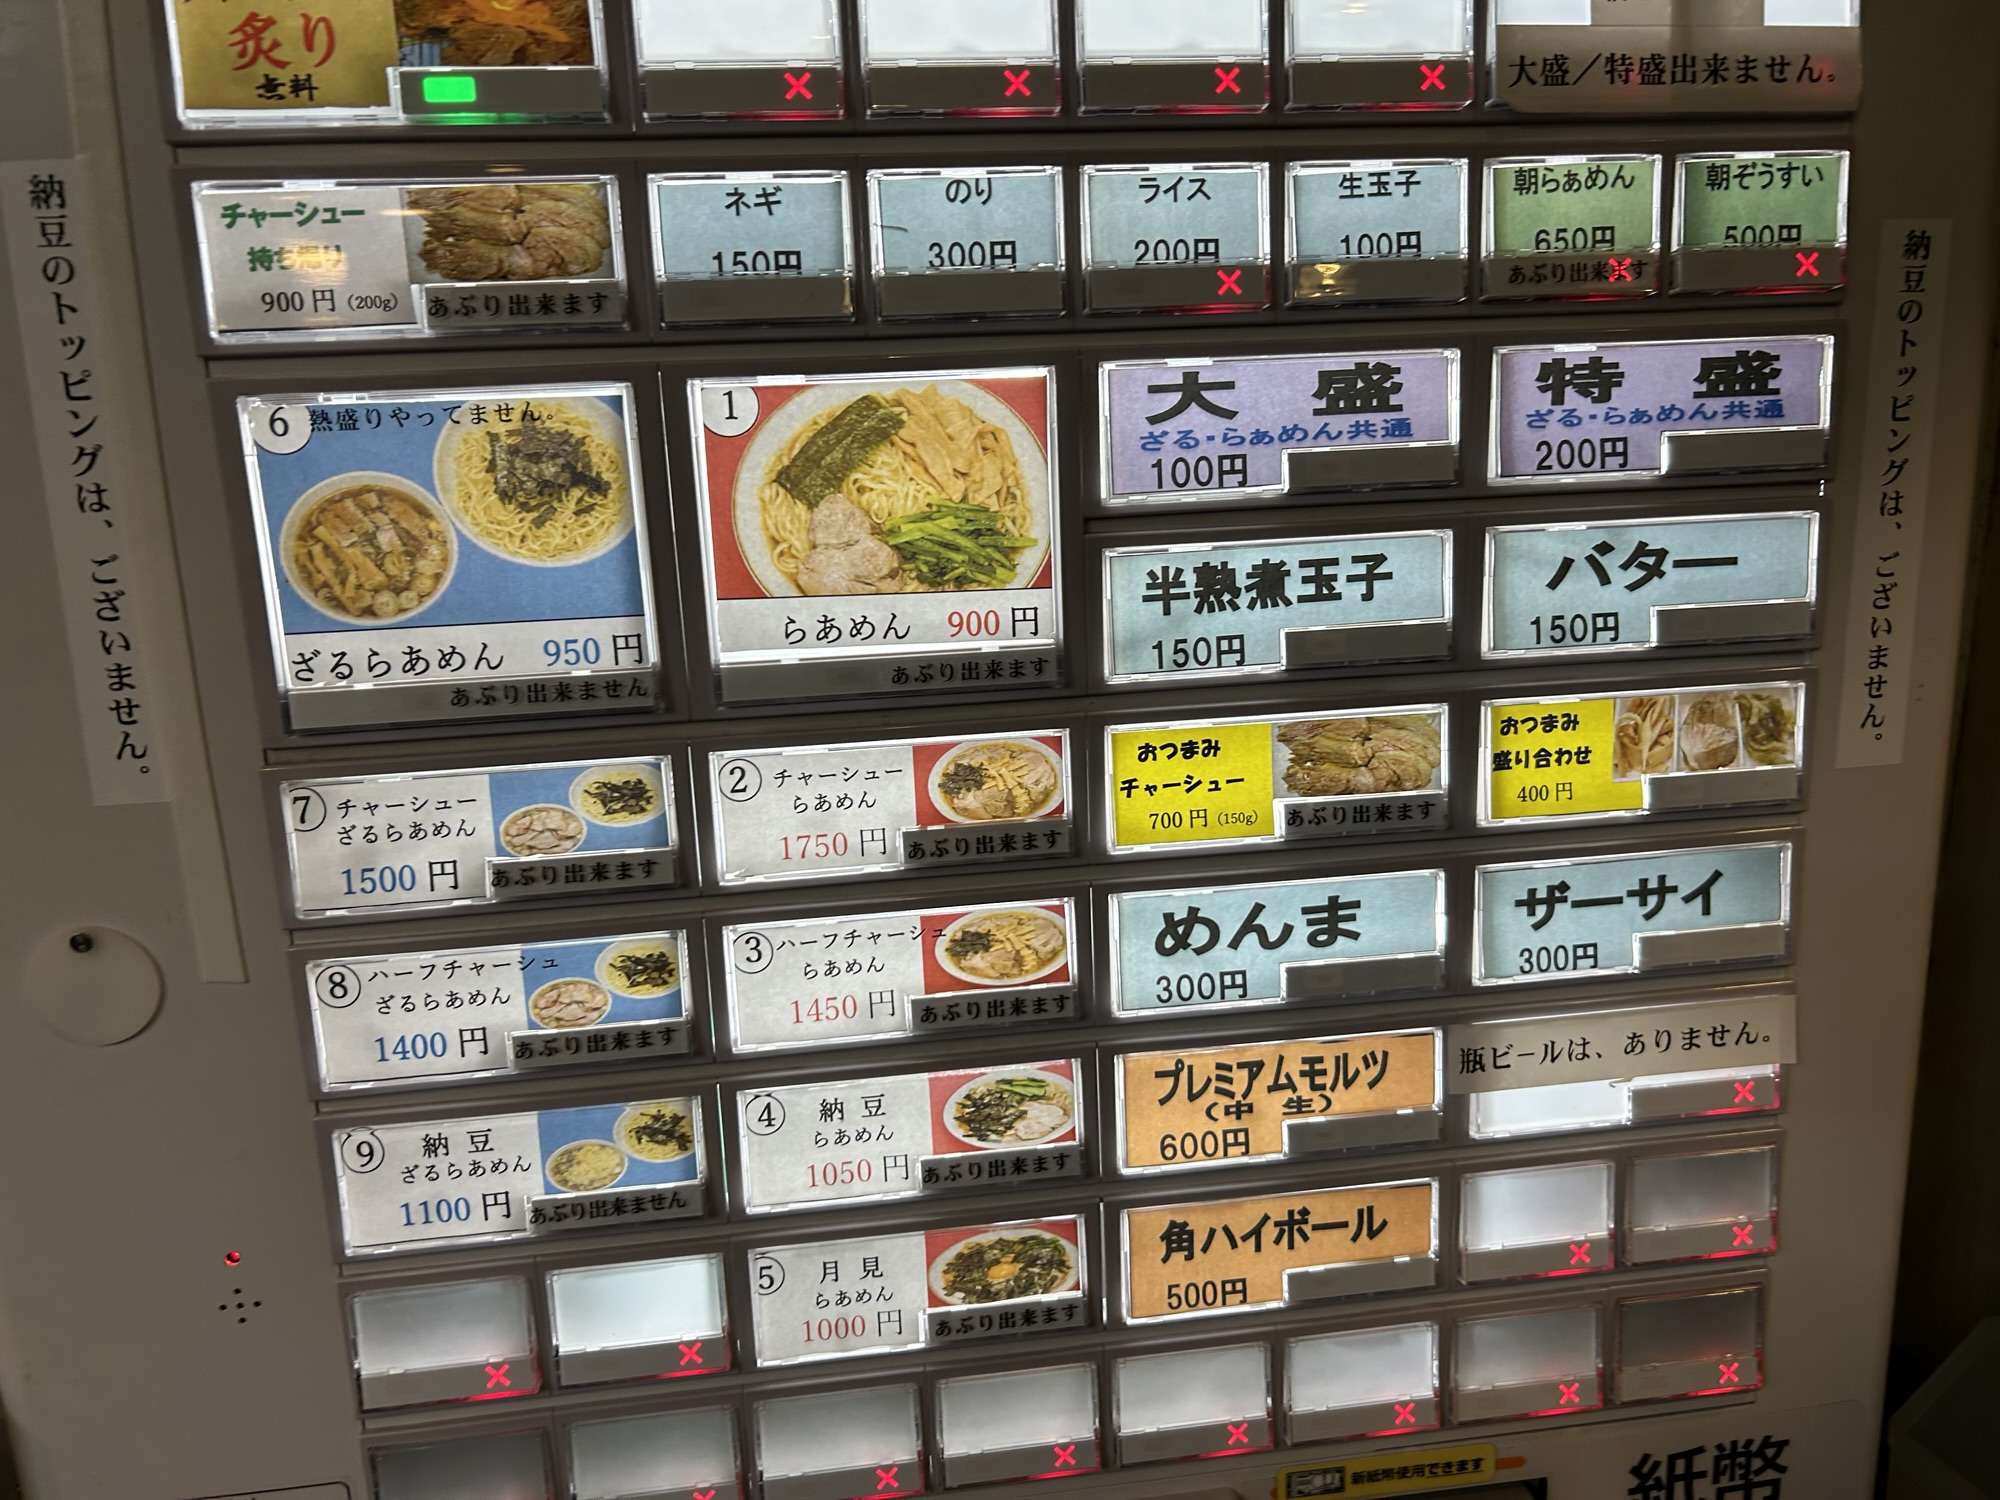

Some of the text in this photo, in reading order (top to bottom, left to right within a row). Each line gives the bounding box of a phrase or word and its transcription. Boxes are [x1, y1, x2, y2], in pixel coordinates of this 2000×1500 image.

[227, 11, 336, 71] 炙り
[1507, 52, 1836, 88] 大盛／特盛出来ません。
[254, 73, 319, 102] 無料
[945, 177, 993, 205] のり
[1138, 175, 1213, 203] ライス
[1338, 170, 1421, 199] 生玉子
[1705, 162, 1824, 191] 朝ぞうすい
[221, 201, 365, 229] チャーシュー
[724, 186, 783, 216] ネギ
[1340, 230, 1421, 259] 100円
[1535, 224, 1615, 253] 650円
[1724, 224, 1801, 248] 500円
[712, 250, 802, 276] 150円
[928, 240, 1017, 269] 300円
[1134, 237, 1221, 267] 200円
[1509, 259, 1648, 284] あぶり出来ます
[428, 292, 608, 318] あぶり出来ます
[310, 402, 557, 433] 熱盛りやってません。
[1535, 436, 1628, 471] 200円
[28, 173, 150, 774] 納豆のトッピングは、ございません。
[1151, 453, 1248, 490] 100円
[1545, 540, 1739, 593] バター
[1142, 553, 1393, 616] 半熟煮玉子
[785, 612, 910, 645] らあめん
[1530, 612, 1619, 645] 150円
[291, 642, 505, 682] ざるらあめん
[1151, 634, 1246, 670] 150円
[891, 658, 1050, 685] あぶり出来ます
[450, 678, 649, 707] あぶり出来ません
[1499, 712, 1580, 737] おつまみ
[1137, 738, 1221, 762] おつまみ
[1492, 745, 1593, 772] 盛り合わせ
[773, 766, 903, 788] チャーシュー
[1120, 774, 1245, 799] チャーシュー
[336, 795, 477, 819] チャーシュー
[793, 790, 877, 814] らあめん
[1287, 801, 1437, 828] あぶり出来ます
[336, 819, 476, 845] ざるらあめん
[780, 832, 848, 860] 1750
[908, 829, 1063, 860] あぶり出来ます
[341, 864, 416, 895] 1500
[490, 858, 659, 888] あぶり出来ます
[1514, 869, 1724, 932] ザーサイ
[1155, 895, 1362, 958] めんま
[804, 956, 885, 980] らあめん
[1519, 942, 1599, 974] 300円
[376, 986, 511, 1016] ざるらあめん
[1156, 970, 1248, 1004] 300円
[790, 994, 857, 1024] 1450
[920, 994, 1071, 1024] あぶり出来ます
[374, 1031, 447, 1063] 1400
[514, 1026, 680, 1060] あぶり出来ます
[1458, 1020, 1771, 1075] 瓶ビールは、ありません。
[1154, 1050, 1389, 1106] プレミアムモルツ
[814, 1124, 894, 1148] らあめん
[1160, 1127, 1251, 1161] 600円
[400, 1156, 532, 1184] ざるらあめん
[807, 1159, 872, 1188] 1050
[923, 1152, 1071, 1183] あぶり出来ます
[401, 1197, 471, 1227] 1100
[530, 1191, 687, 1225] あぶり出来ません
[1160, 1204, 1389, 1264] 角ハイボール
[815, 1286, 894, 1309] らあめん
[1167, 1277, 1248, 1311] 500円
[803, 1315, 866, 1342] 1000
[934, 1303, 1079, 1338] あぶり出来ます
[1627, 1434, 1791, 1500] 紙幣
